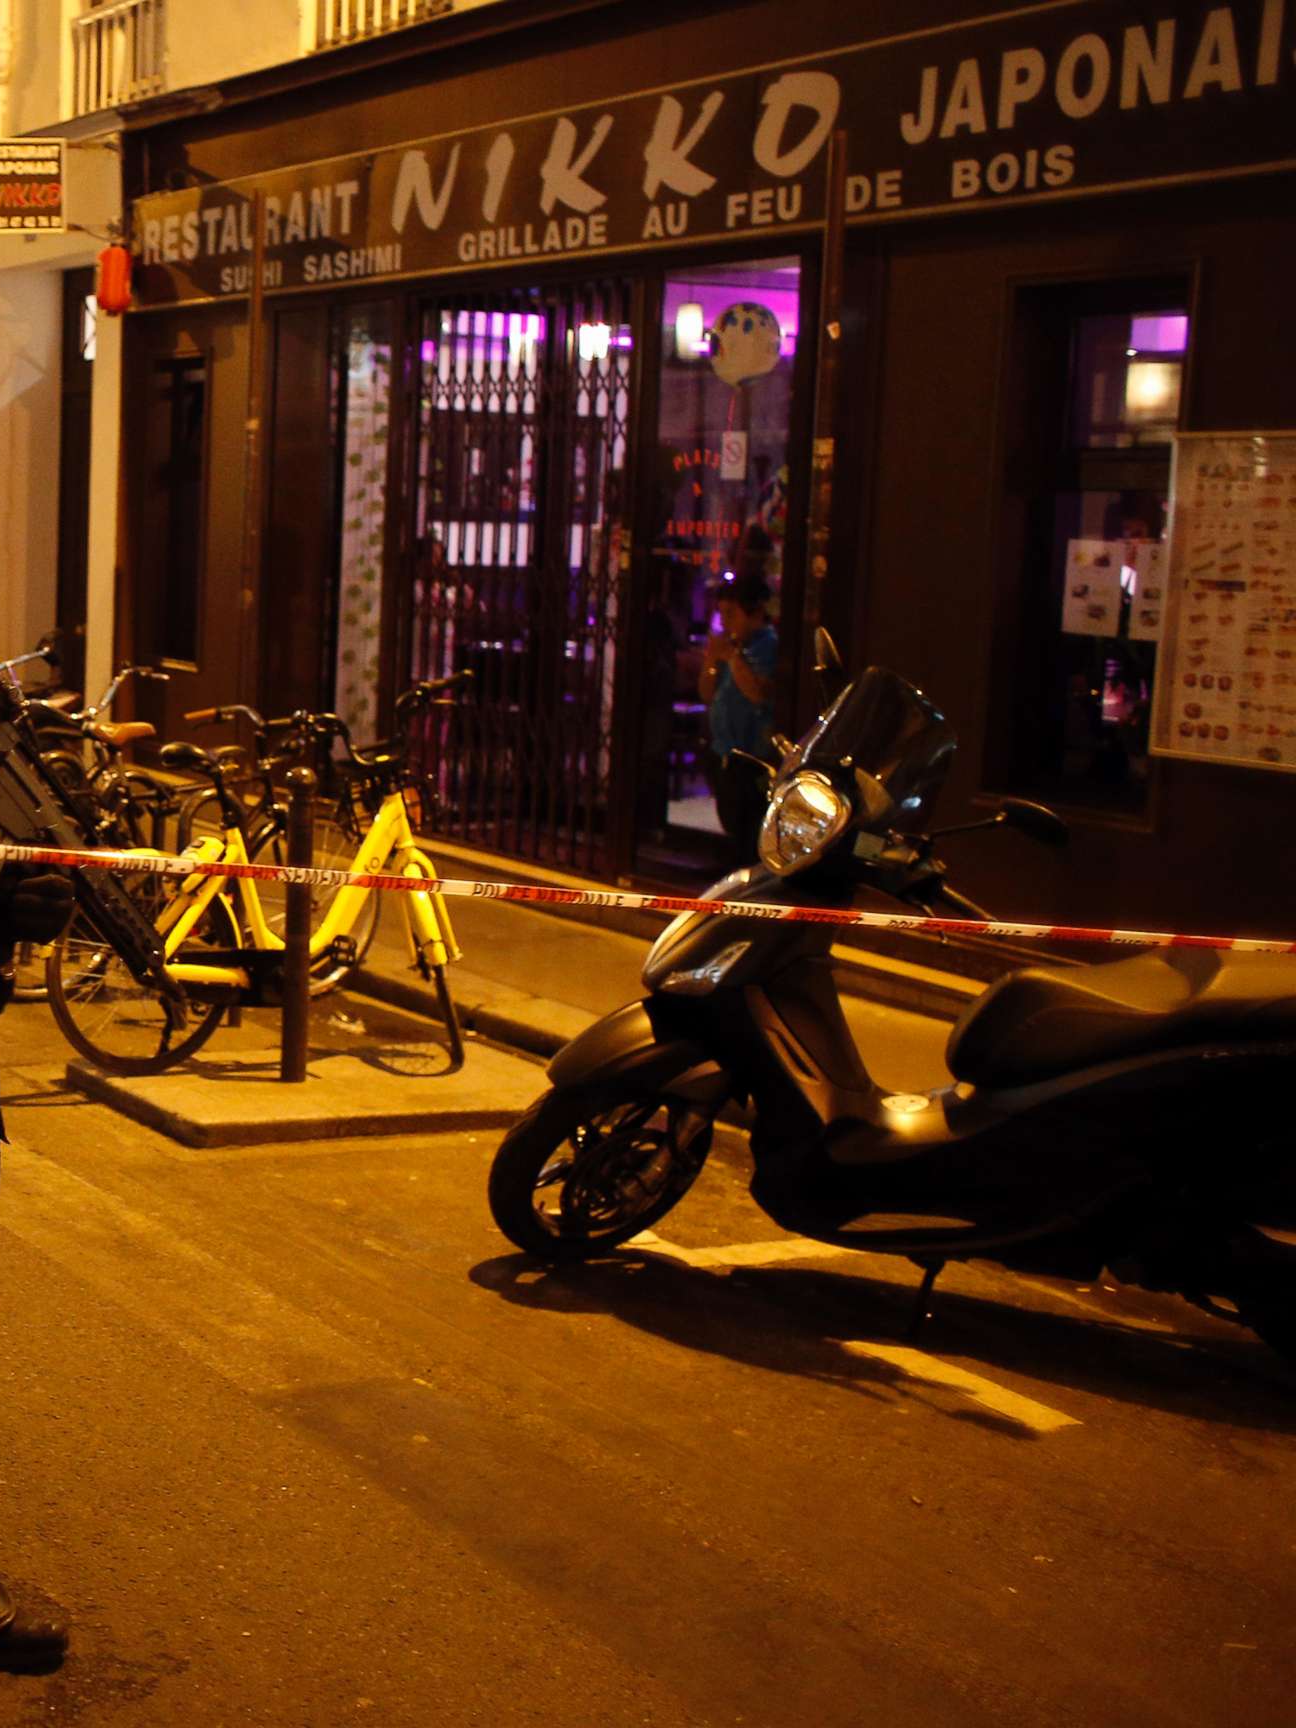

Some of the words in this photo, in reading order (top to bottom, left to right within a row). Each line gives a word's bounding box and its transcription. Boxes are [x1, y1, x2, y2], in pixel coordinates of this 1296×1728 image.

[392, 71, 841, 234] NIKKO
[901, 0, 1296, 144] JAPONAI
[221, 260, 283, 293] SUHI
[304, 243, 402, 283] SASHIMI
[459, 213, 608, 263] GRILLADE
[643, 203, 689, 239] AU
[726, 185, 802, 229] FEU
[846, 169, 904, 212] DE
[952, 145, 1075, 199] BOIS
